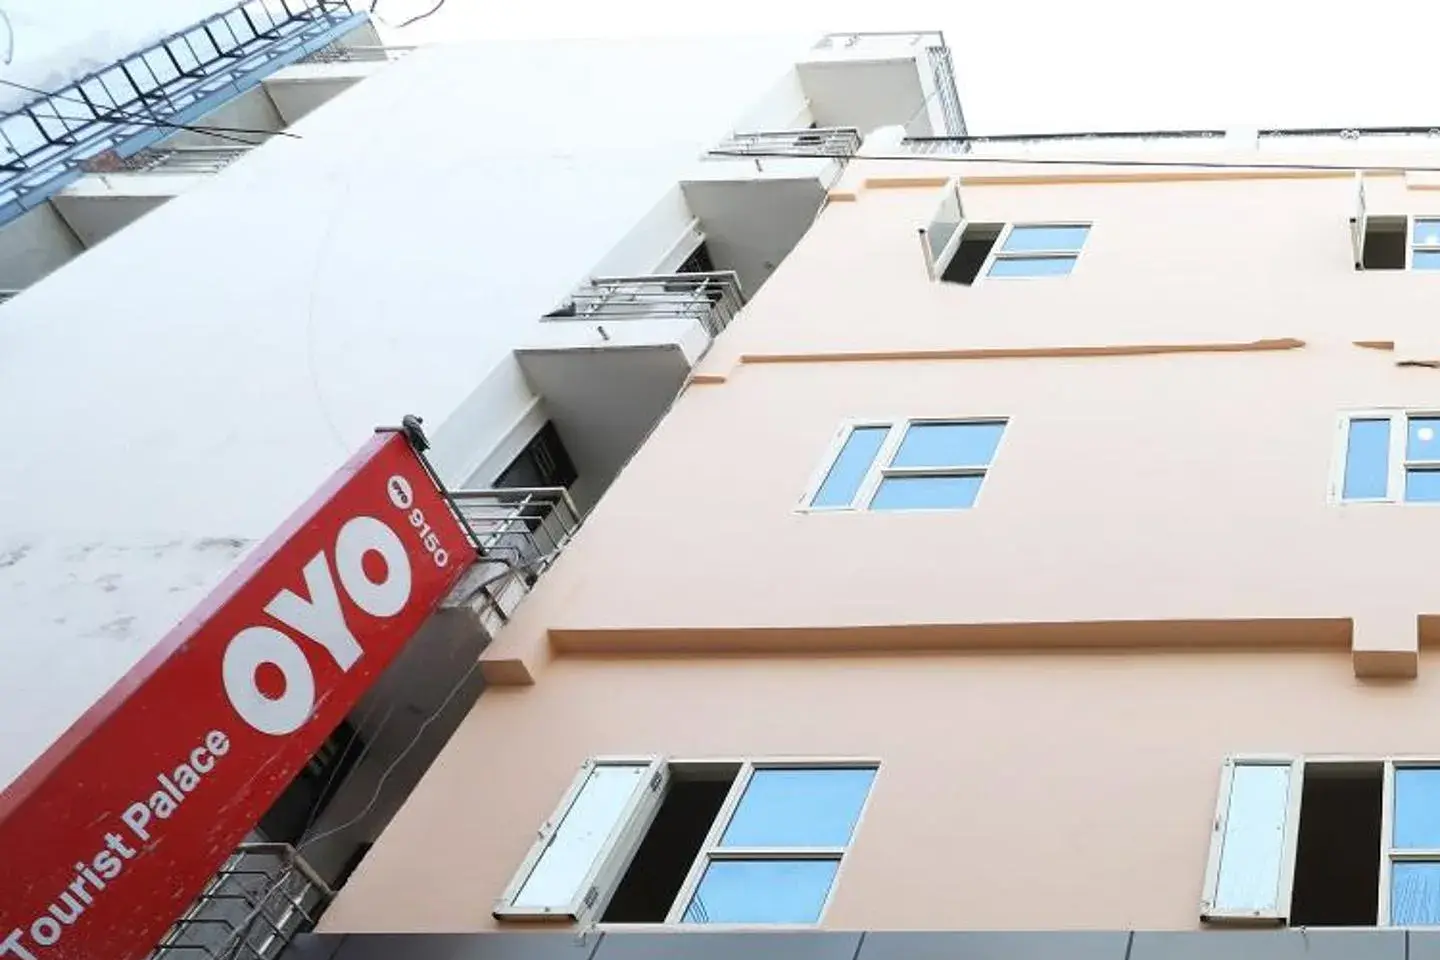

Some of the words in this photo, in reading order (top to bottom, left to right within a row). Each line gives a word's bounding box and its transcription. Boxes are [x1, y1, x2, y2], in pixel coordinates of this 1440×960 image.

[408, 508, 449, 568] 9150
[222, 515, 412, 736] OYO
[121, 729, 230, 842] Palace
